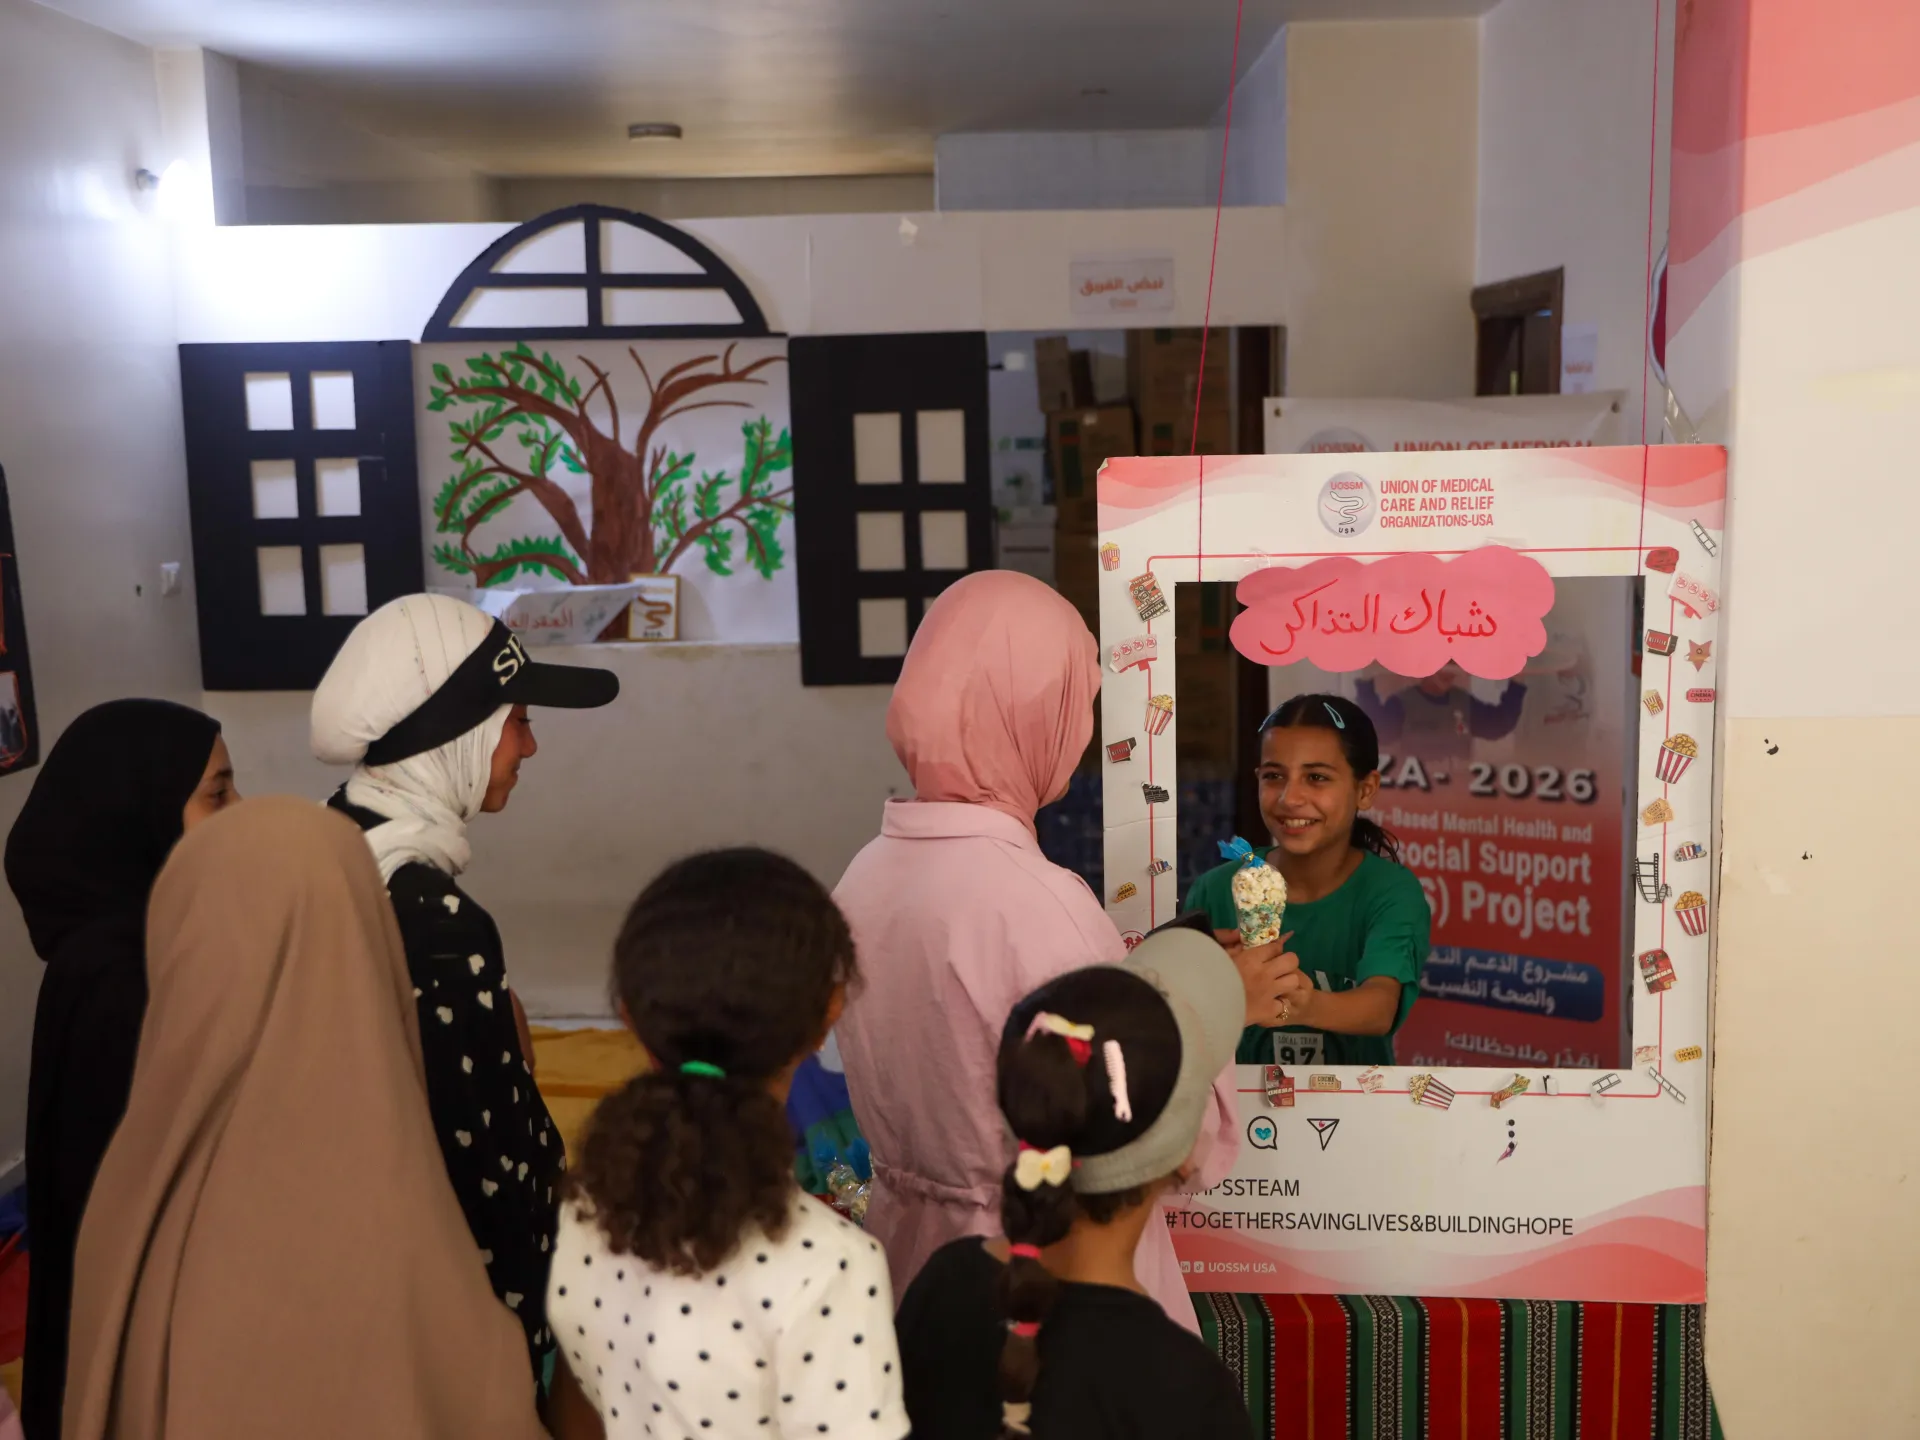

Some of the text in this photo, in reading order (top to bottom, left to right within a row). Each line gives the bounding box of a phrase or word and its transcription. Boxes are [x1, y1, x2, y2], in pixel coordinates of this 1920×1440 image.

[1330, 481, 1364, 490] UOSSM
[1380, 478, 1494, 494] UNION OF MEDICAL
[1380, 496, 1494, 512] CARE AND RELIEF
[1380, 514, 1494, 528] ORGANIZATIONS-USA
[1142, 602, 1164, 620] FESTIVAL
[1259, 578, 1498, 655] شباك التذاكر
[1379, 754, 1594, 801] ZA- 2026
[1442, 812, 1498, 835] Mental
[1503, 817, 1557, 841] Health
[1561, 824, 1592, 844] and
[1398, 837, 1591, 887] social Support
[1462, 881, 1591, 939] Project
[1464, 952, 1518, 976] الدعم
[1645, 968, 1673, 983] CINEMA
[1300, 1036, 1318, 1045] TEAM
[1677, 1050, 1699, 1059] TICKET
[1180, 1179, 1300, 1197] SSTEAM
[1165, 1211, 1574, 1236] #TOGETHERSAVINGLIVES&BUILDINGHOPE
[1208, 1262, 1250, 1273] UOSSM
[1253, 1263, 1277, 1273] USA
